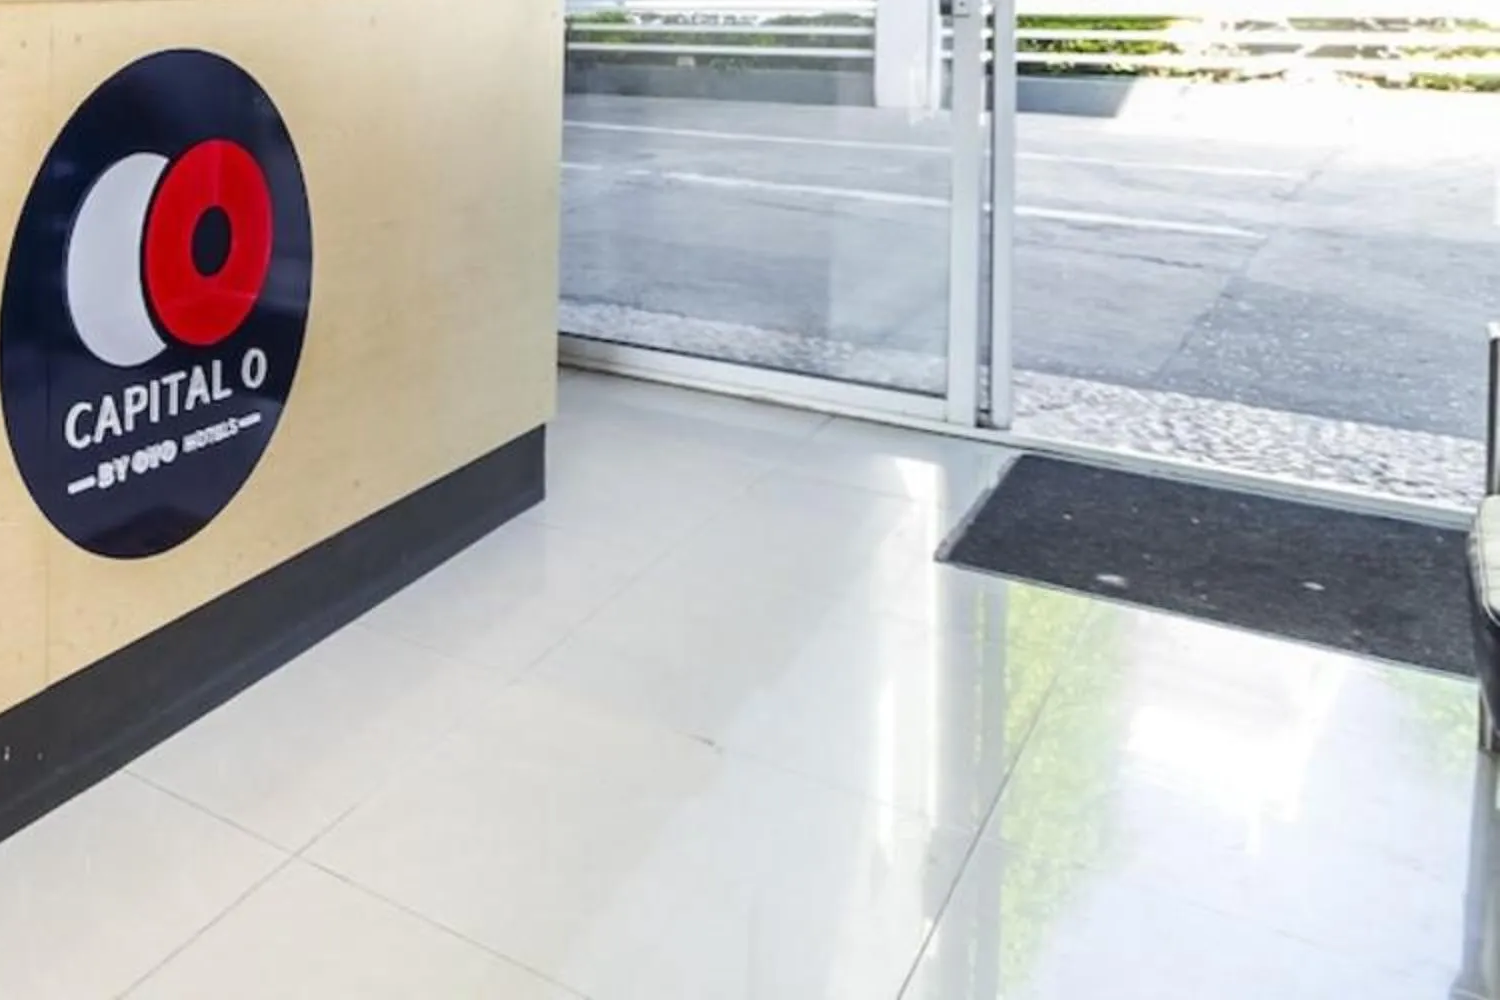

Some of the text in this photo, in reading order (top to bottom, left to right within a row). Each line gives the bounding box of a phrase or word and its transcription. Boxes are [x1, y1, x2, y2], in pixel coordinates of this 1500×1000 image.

[64, 347, 268, 450] CAPITAL O
[97, 455, 131, 489] BY
